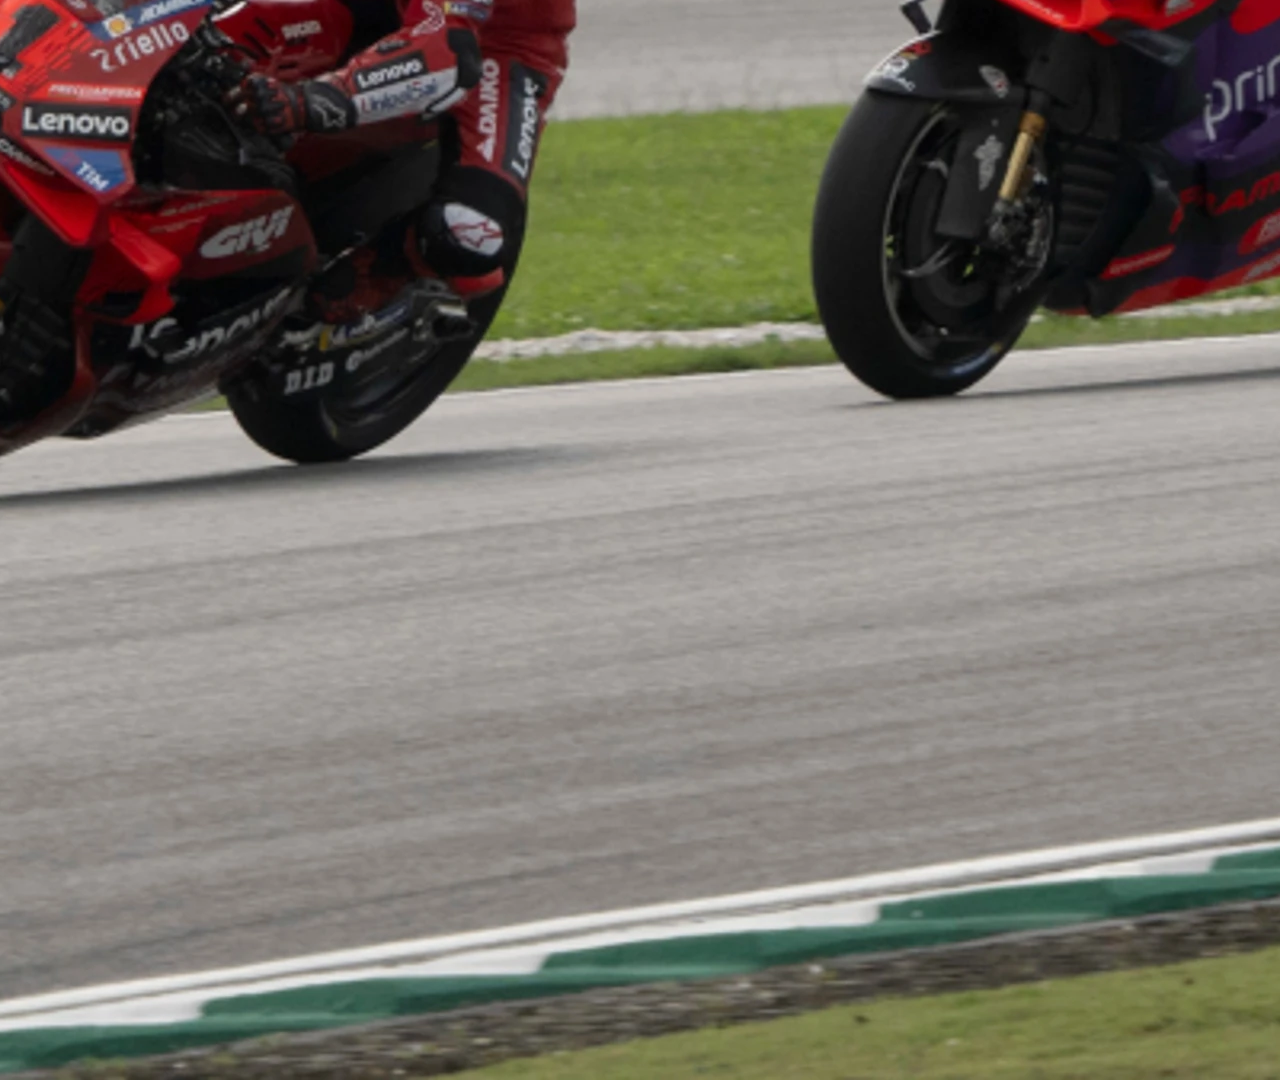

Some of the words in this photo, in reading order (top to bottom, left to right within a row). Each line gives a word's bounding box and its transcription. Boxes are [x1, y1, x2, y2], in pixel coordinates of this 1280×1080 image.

[113, 20, 191, 66] riello
[356, 56, 424, 89] Lenovo
[21, 105, 131, 137] Lenovo
[75, 160, 110, 191] TIM
[199, 204, 294, 259] GIVI
